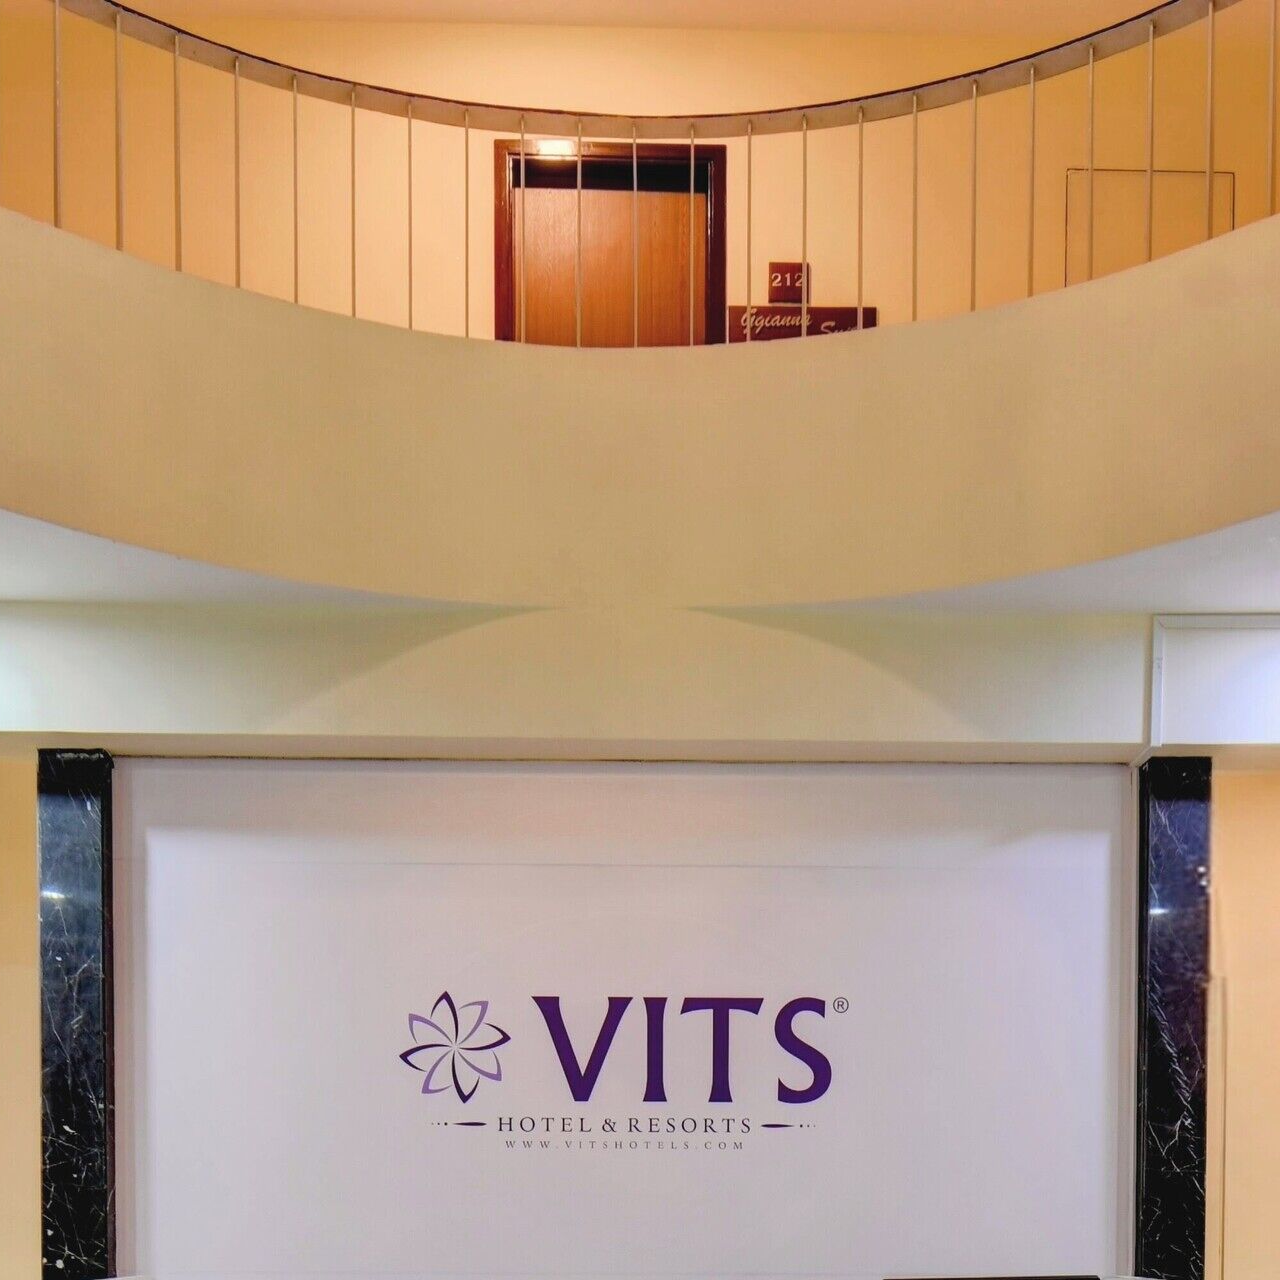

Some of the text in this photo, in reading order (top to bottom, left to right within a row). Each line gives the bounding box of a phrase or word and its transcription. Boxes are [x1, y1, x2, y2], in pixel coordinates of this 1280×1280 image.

[771, 272, 804, 287] 212
[531, 996, 833, 1104] VITS
[497, 1116, 752, 1134] HOTEL & RESORTS
